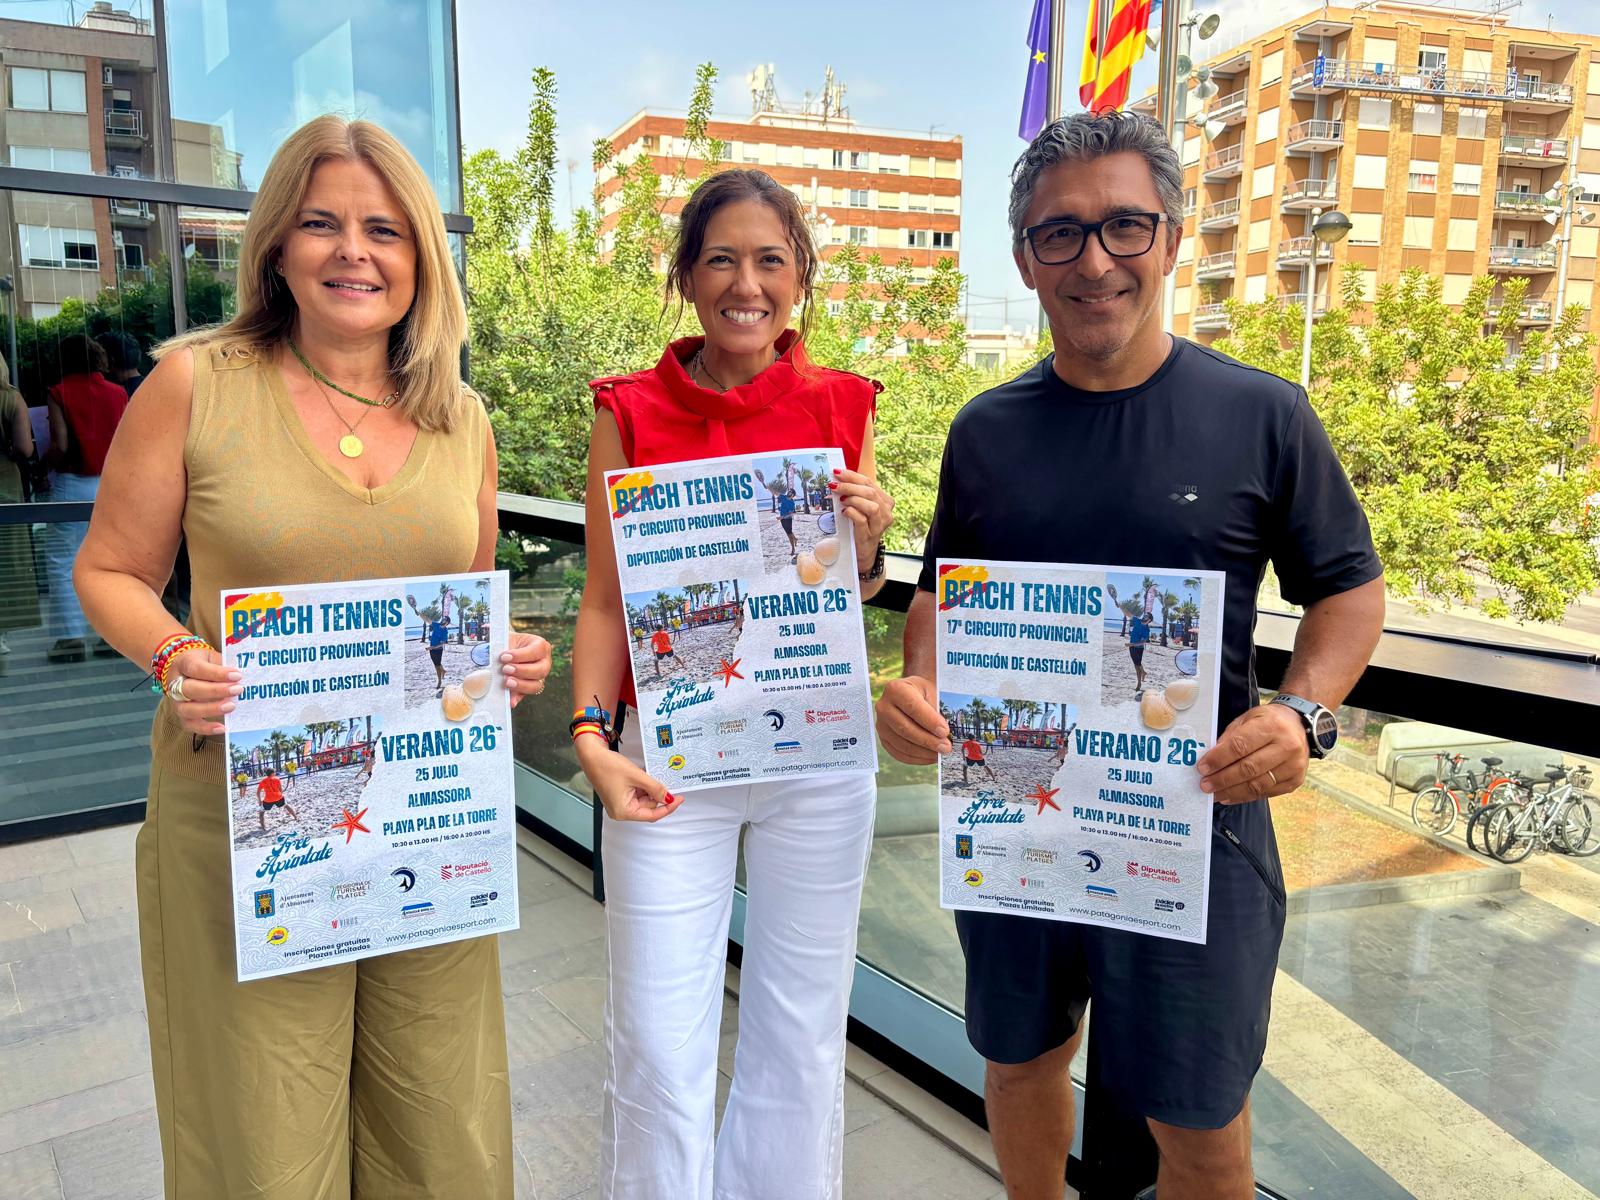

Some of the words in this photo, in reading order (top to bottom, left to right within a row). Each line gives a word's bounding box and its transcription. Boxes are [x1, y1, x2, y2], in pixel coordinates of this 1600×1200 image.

[615, 482, 680, 515] BEACH
[683, 473, 754, 506] TENNIS
[639, 517, 685, 537] CIRCUITO
[688, 511, 747, 530] PROVINCIAL
[627, 546, 684, 568] DIPUTACIÓN
[685, 546, 697, 559] DE
[698, 537, 749, 557] CASTELLÓN
[748, 591, 819, 620] VERANO
[945, 579, 1014, 611] BEACH
[1021, 583, 1103, 617] TENNIS
[232, 604, 312, 640] BEACH
[320, 598, 403, 632] TENNIS
[779, 625, 790, 637] 25
[793, 623, 815, 635] JULIO
[965, 620, 1016, 638] CIRCUITO
[1020, 624, 1089, 644] PROVINCIAL
[258, 646, 317, 666] CIRCUITO
[320, 640, 391, 661] PROVINCIAL
[774, 644, 828, 659] ALMASSORA
[754, 669, 781, 682] PLAYA
[783, 667, 799, 680] PLA
[801, 666, 811, 678] DE
[813, 665, 823, 677] LA
[824, 663, 852, 676] TORRE
[947, 651, 1008, 670] DIPUTACIÓN
[1011, 656, 1024, 671] DE
[1027, 656, 1086, 676] CASTELLÓN
[238, 678, 309, 701] DIPUTACIÓN
[313, 678, 327, 693] DE
[329, 670, 390, 691] CASTELLÓN
[667, 677, 696, 699] Free
[656, 686, 715, 719] Apúntate
[817, 709, 846, 718] Diputació
[381, 728, 464, 762] VERANO
[1075, 729, 1161, 763] VERANO
[415, 767, 429, 781] 25
[432, 764, 458, 780] JULIO
[683, 771, 722, 780] Inscripciones
[723, 767, 750, 777] gratuitas
[701, 775, 721, 783] Plazas
[721, 772, 751, 781] Limitadas
[762, 760, 857, 774] www.patagoniaesport.com
[1108, 768, 1122, 781] 25
[1124, 770, 1153, 785] JULIO
[408, 787, 471, 808] ALMASSORA
[972, 790, 1007, 810] Free
[1098, 789, 1165, 810] ALMASSORA
[383, 819, 415, 835] PLAYA
[417, 816, 436, 832] PLA
[438, 814, 450, 828] DE
[453, 812, 465, 826] LA
[467, 808, 497, 824] TORRE
[958, 807, 1025, 831] Apúntate
[1073, 806, 1104, 822] PLAYA
[1106, 811, 1126, 826] PLA
[1128, 814, 1141, 829] DE
[1143, 817, 1155, 831] LA
[1158, 819, 1191, 837] TORRE
[272, 831, 311, 857] Free
[465, 830, 482, 838] 20:00
[1132, 834, 1148, 842] 16:00
[1155, 838, 1172, 846] 20:00
[256, 841, 334, 883] Apúntate
[454, 860, 488, 871] Diputació
[1141, 865, 1177, 876] Diputació
[279, 891, 314, 901] Ajuntament
[336, 891, 366, 900] PLATGES
[337, 886, 366, 895] TURISME
[978, 894, 1022, 903] Inscripciones
[1023, 899, 1055, 907] gratuitas
[999, 901, 1020, 909] Plazas
[1021, 903, 1055, 913] Limitadas
[386, 916, 496, 942] www.patagoniaesport.com
[1069, 906, 1181, 931] www.patagoniaesport.com
[284, 944, 335, 958] Inscripciones
[336, 937, 371, 950] gratuitas
[308, 950, 333, 960] Plazas
[334, 944, 371, 955] Limitadas
